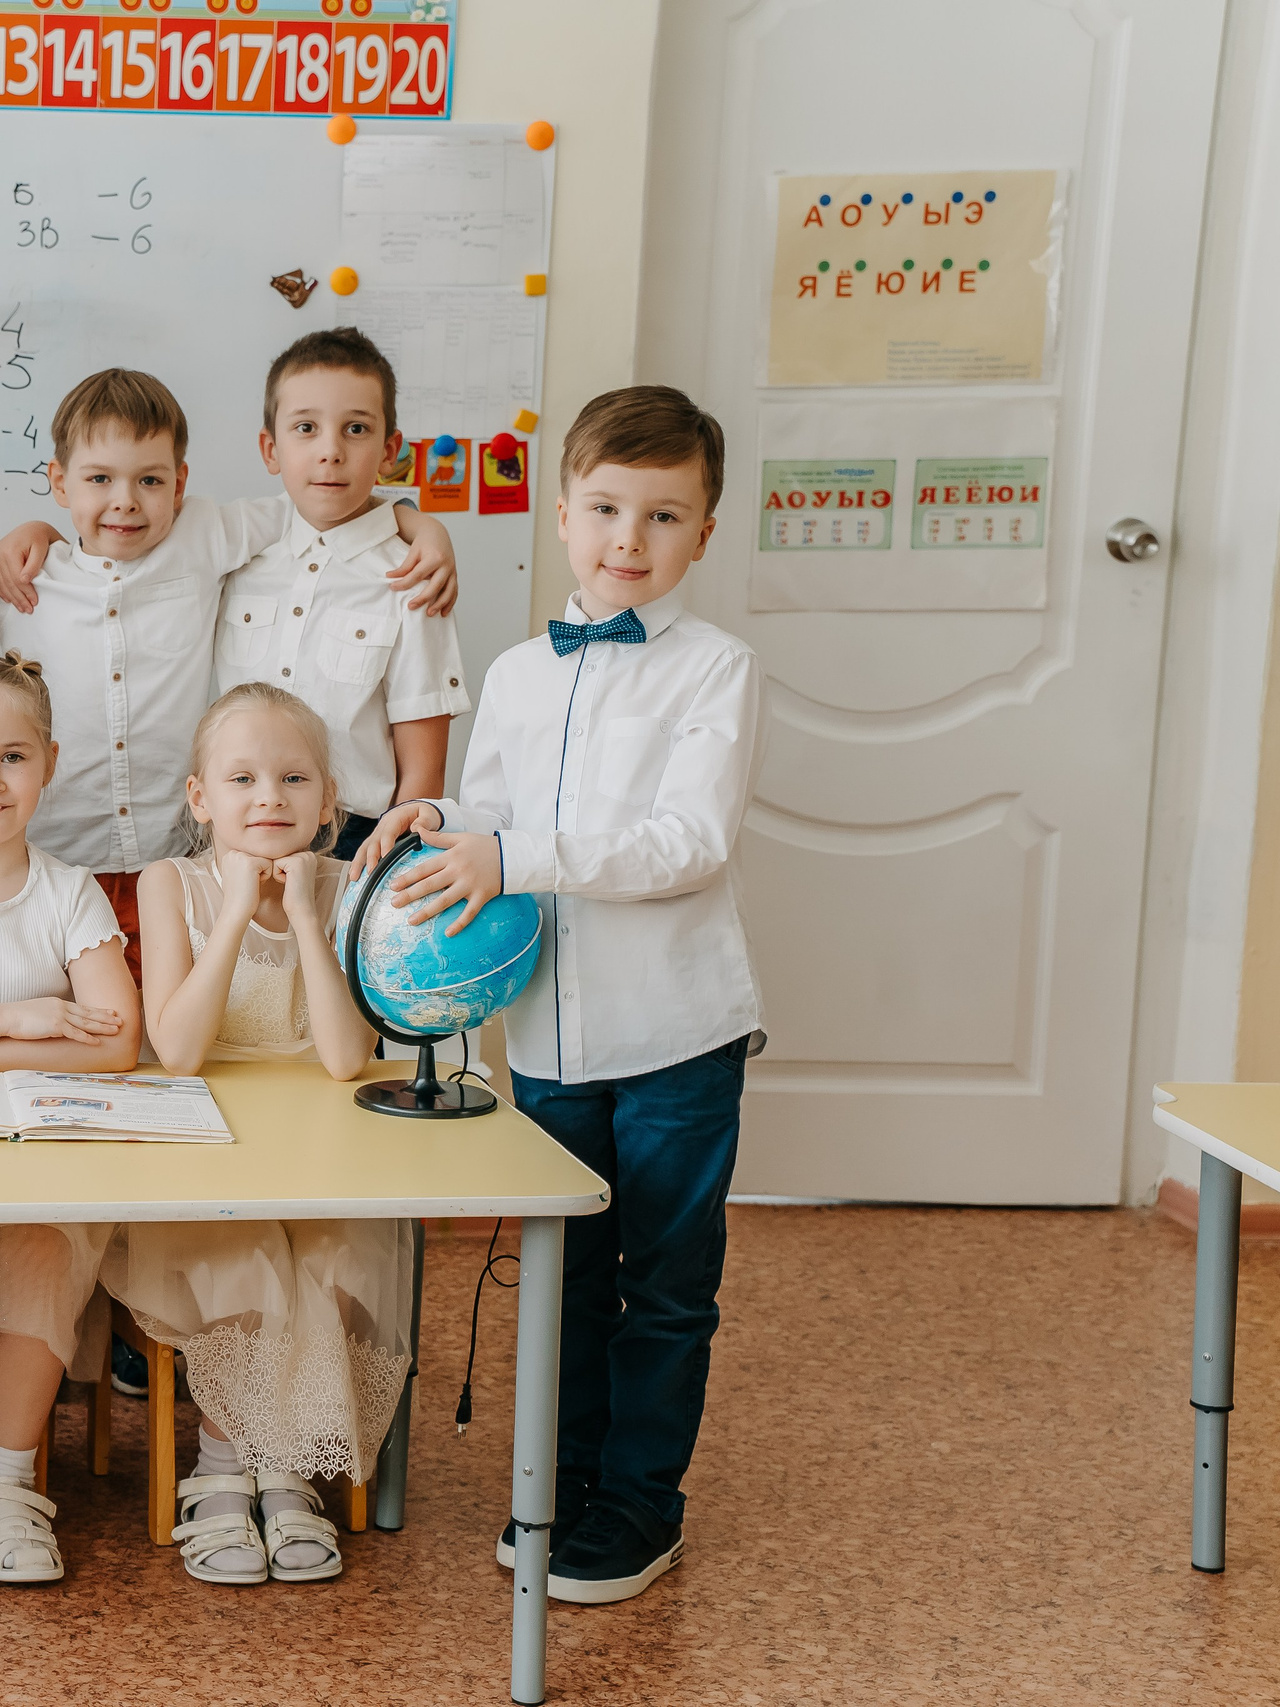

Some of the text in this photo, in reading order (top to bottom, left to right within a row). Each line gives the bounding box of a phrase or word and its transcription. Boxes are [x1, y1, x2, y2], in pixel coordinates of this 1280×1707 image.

[43, 28, 98, 98] 14
[102, 29, 157, 99] 15
[160, 30, 214, 101] 16
[218, 33, 275, 102] 17
[276, 33, 330, 103] 18
[334, 34, 389, 104] 19
[389, 35, 446, 105] 20
[802, 201, 984, 229] А О У Ы Э
[796, 269, 977, 299] Я Ё Ю И Е
